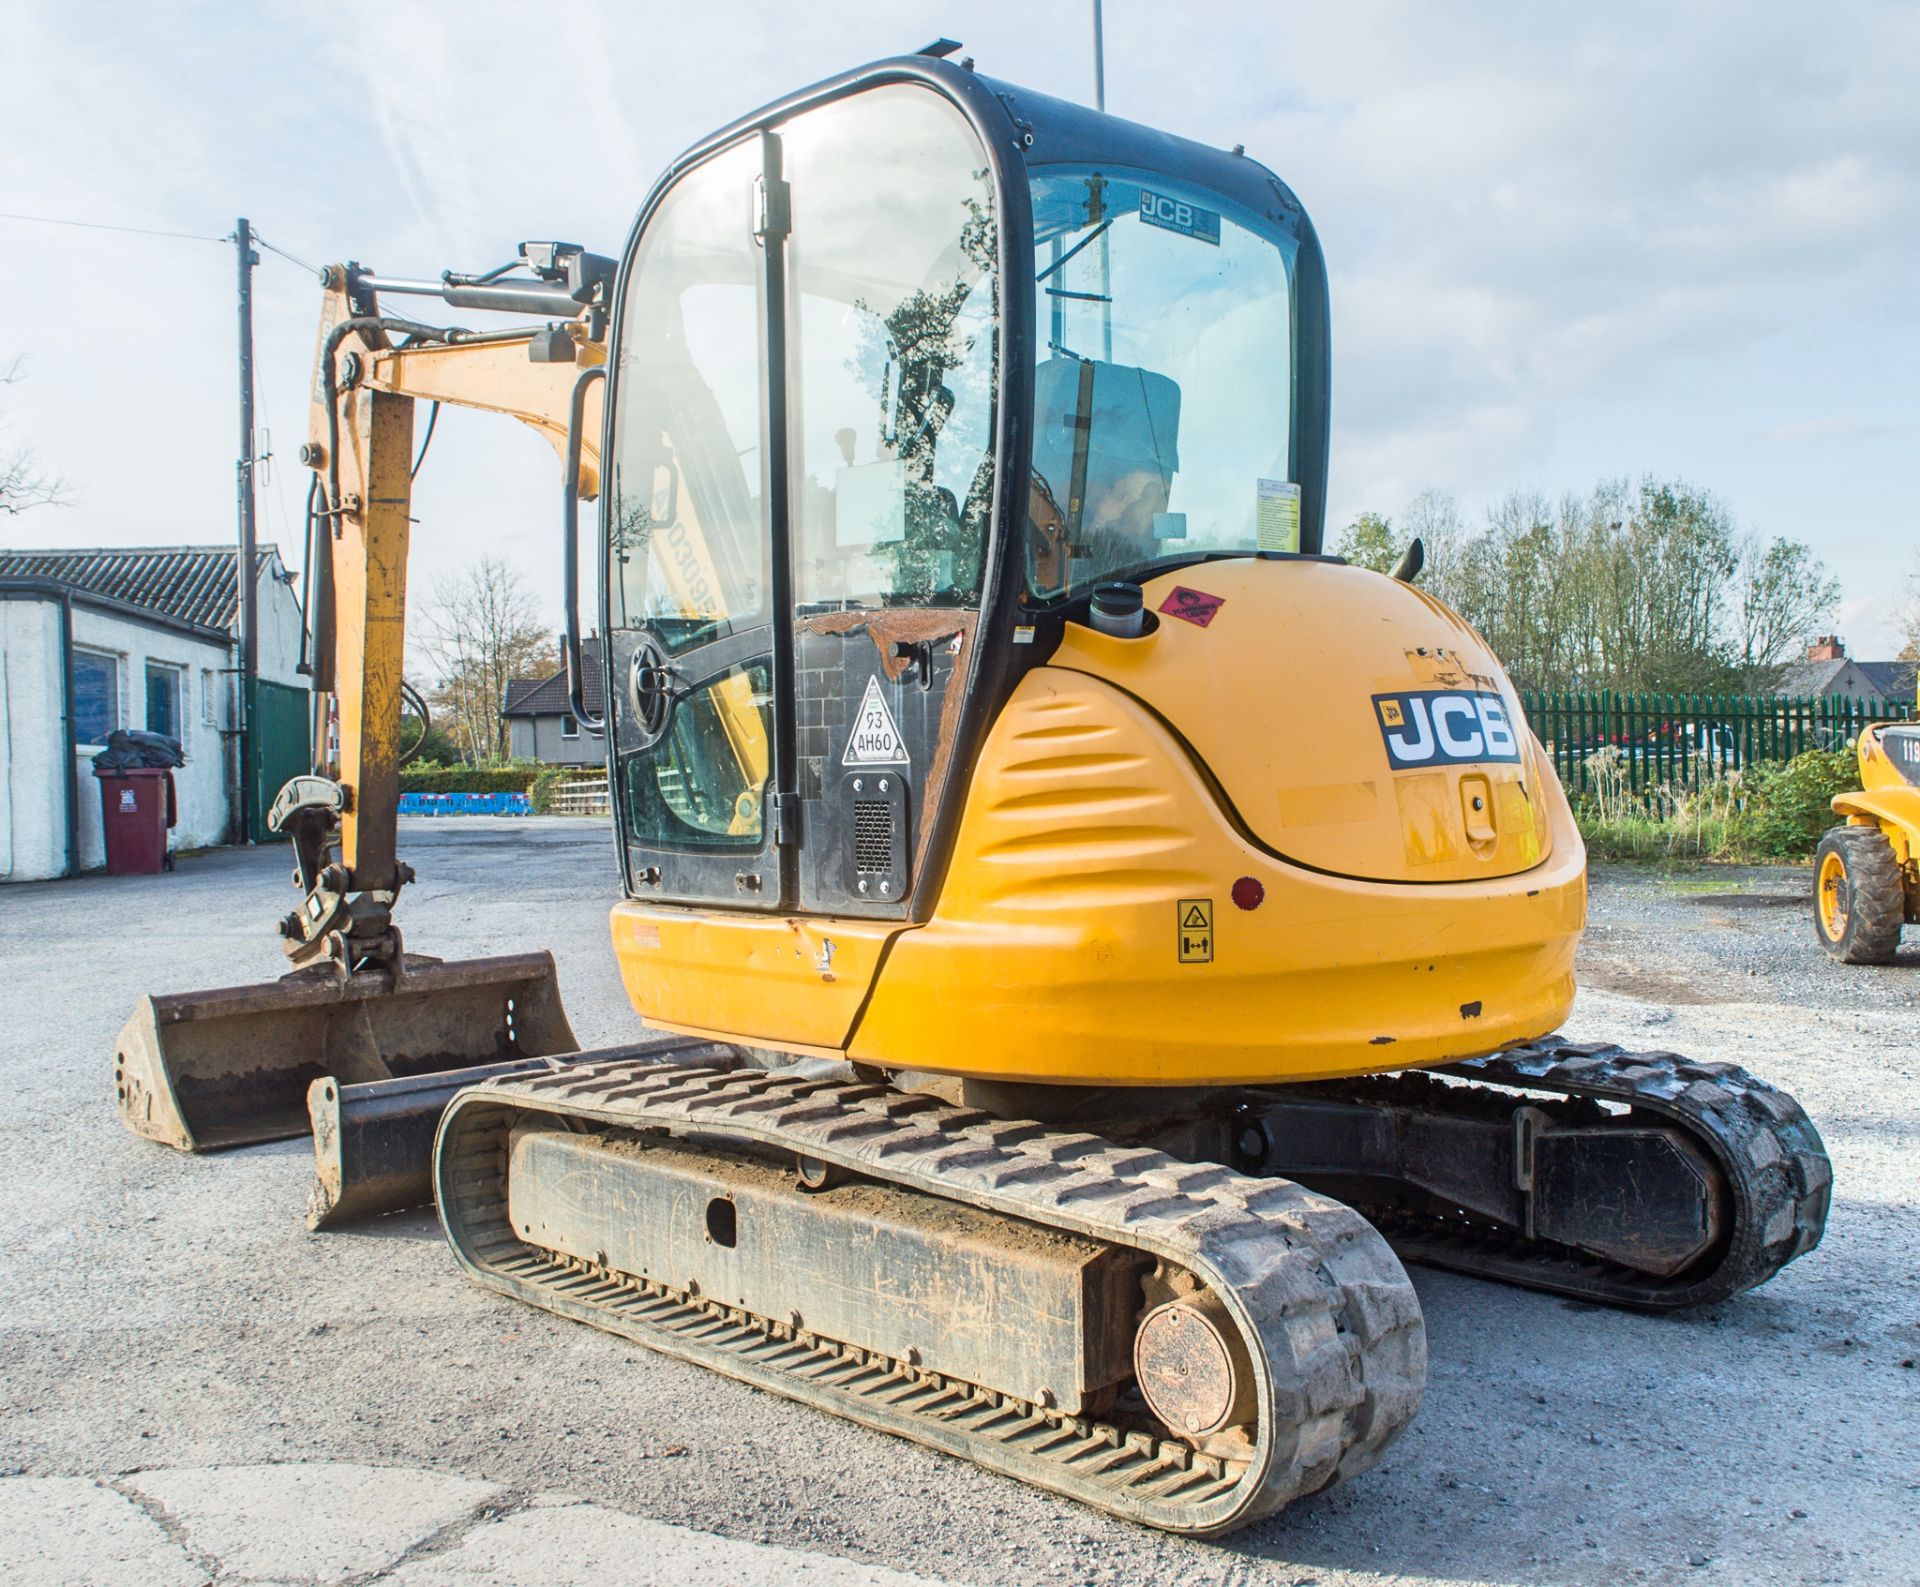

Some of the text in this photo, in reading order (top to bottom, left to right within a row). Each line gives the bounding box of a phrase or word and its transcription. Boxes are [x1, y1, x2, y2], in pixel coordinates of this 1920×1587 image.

[1142, 194, 1192, 227] JCB
[866, 711, 883, 730] 93
[1388, 696, 1517, 761] JCB
[858, 733, 892, 752] AH60
